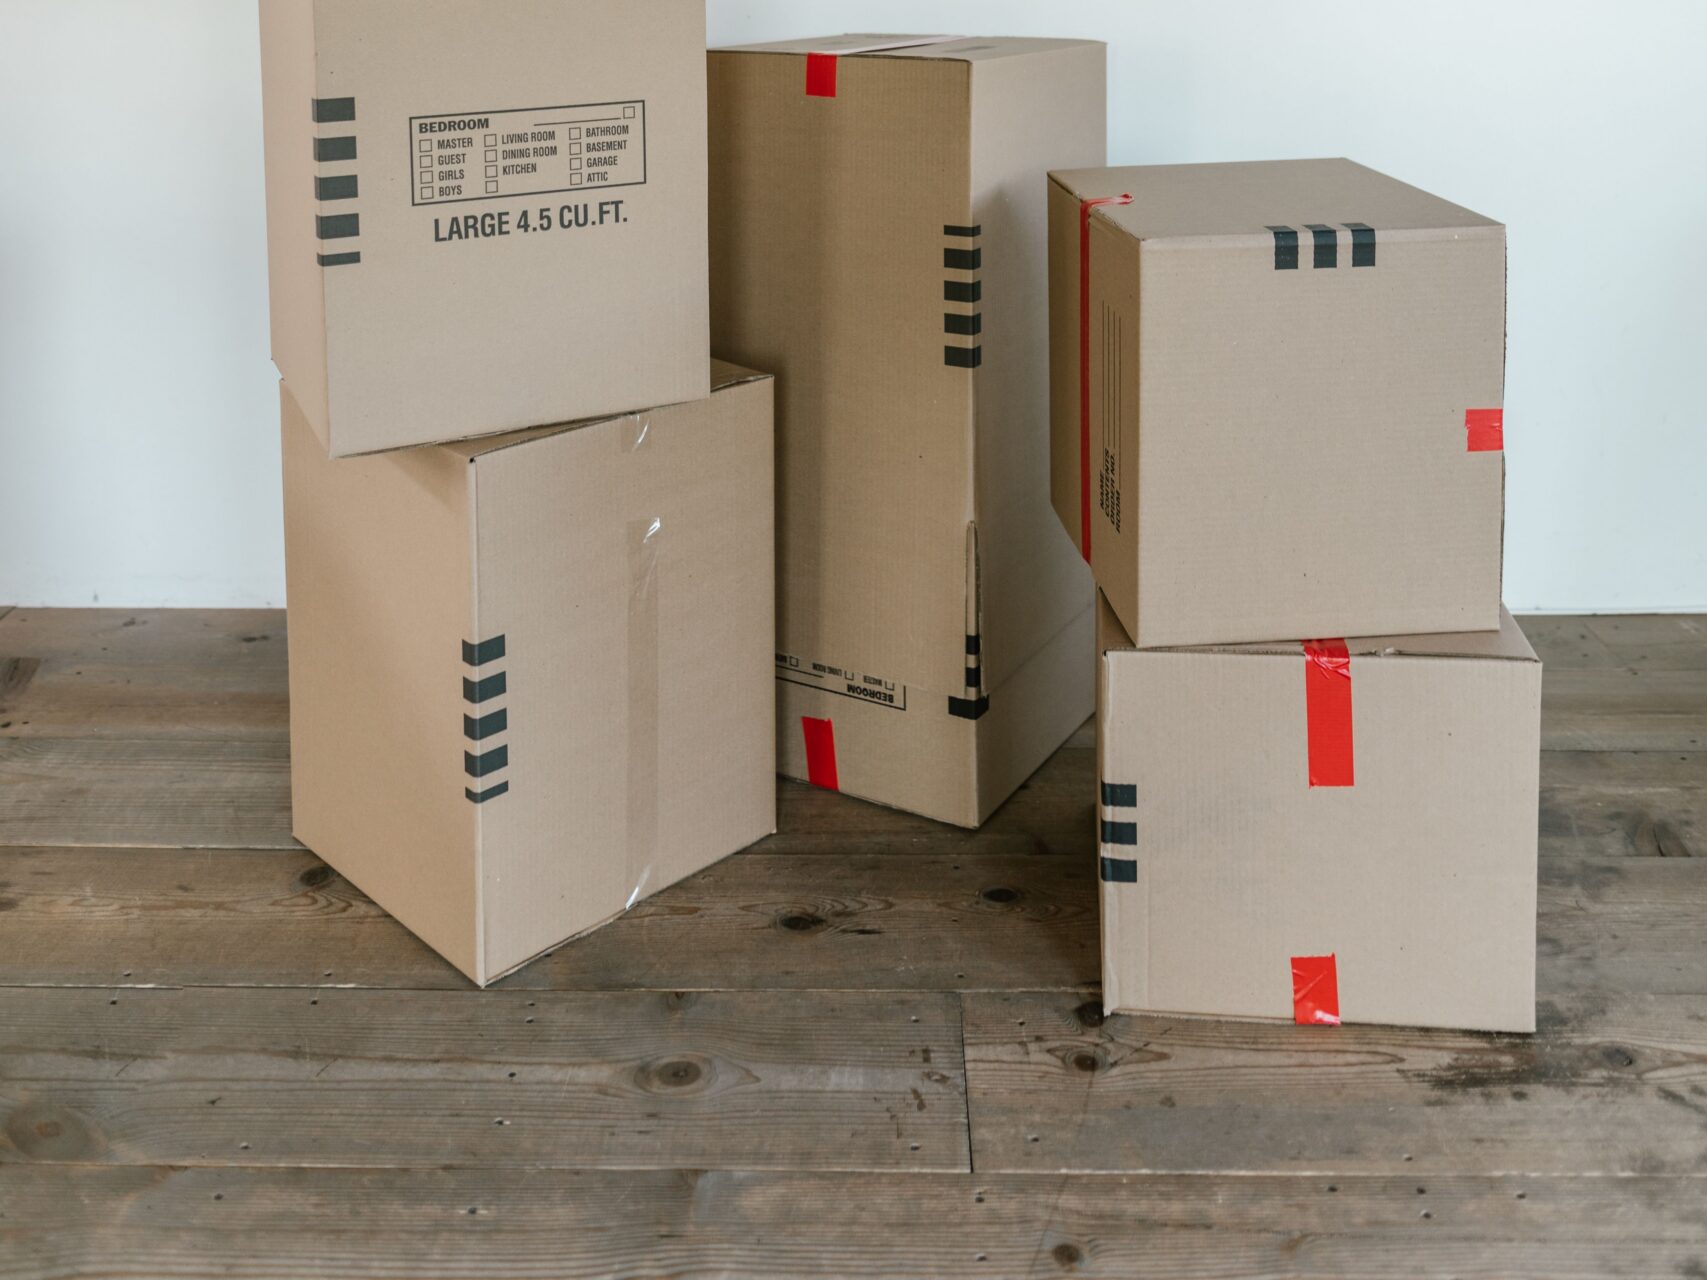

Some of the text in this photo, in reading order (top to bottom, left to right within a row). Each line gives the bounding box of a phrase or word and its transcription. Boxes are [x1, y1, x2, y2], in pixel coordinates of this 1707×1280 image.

[419, 118, 490, 134] BEDROOM
[585, 124, 629, 138] BATHROOM
[437, 137, 473, 150] MASTER
[501, 130, 556, 145] LIVING ROOM
[586, 140, 627, 153] BASEMENT
[437, 154, 466, 166] GUEST
[502, 146, 557, 161] DINING ROOM
[586, 155, 618, 168] GARAGE
[438, 169, 464, 182] GIRLS
[502, 163, 537, 176] KITCHEN
[586, 171, 608, 183] ATTIC
[439, 185, 462, 197] BOYS
[434, 200, 628, 242] LARGE 4.5 CU.FT.
[847, 683, 894, 703] BEDROOM
